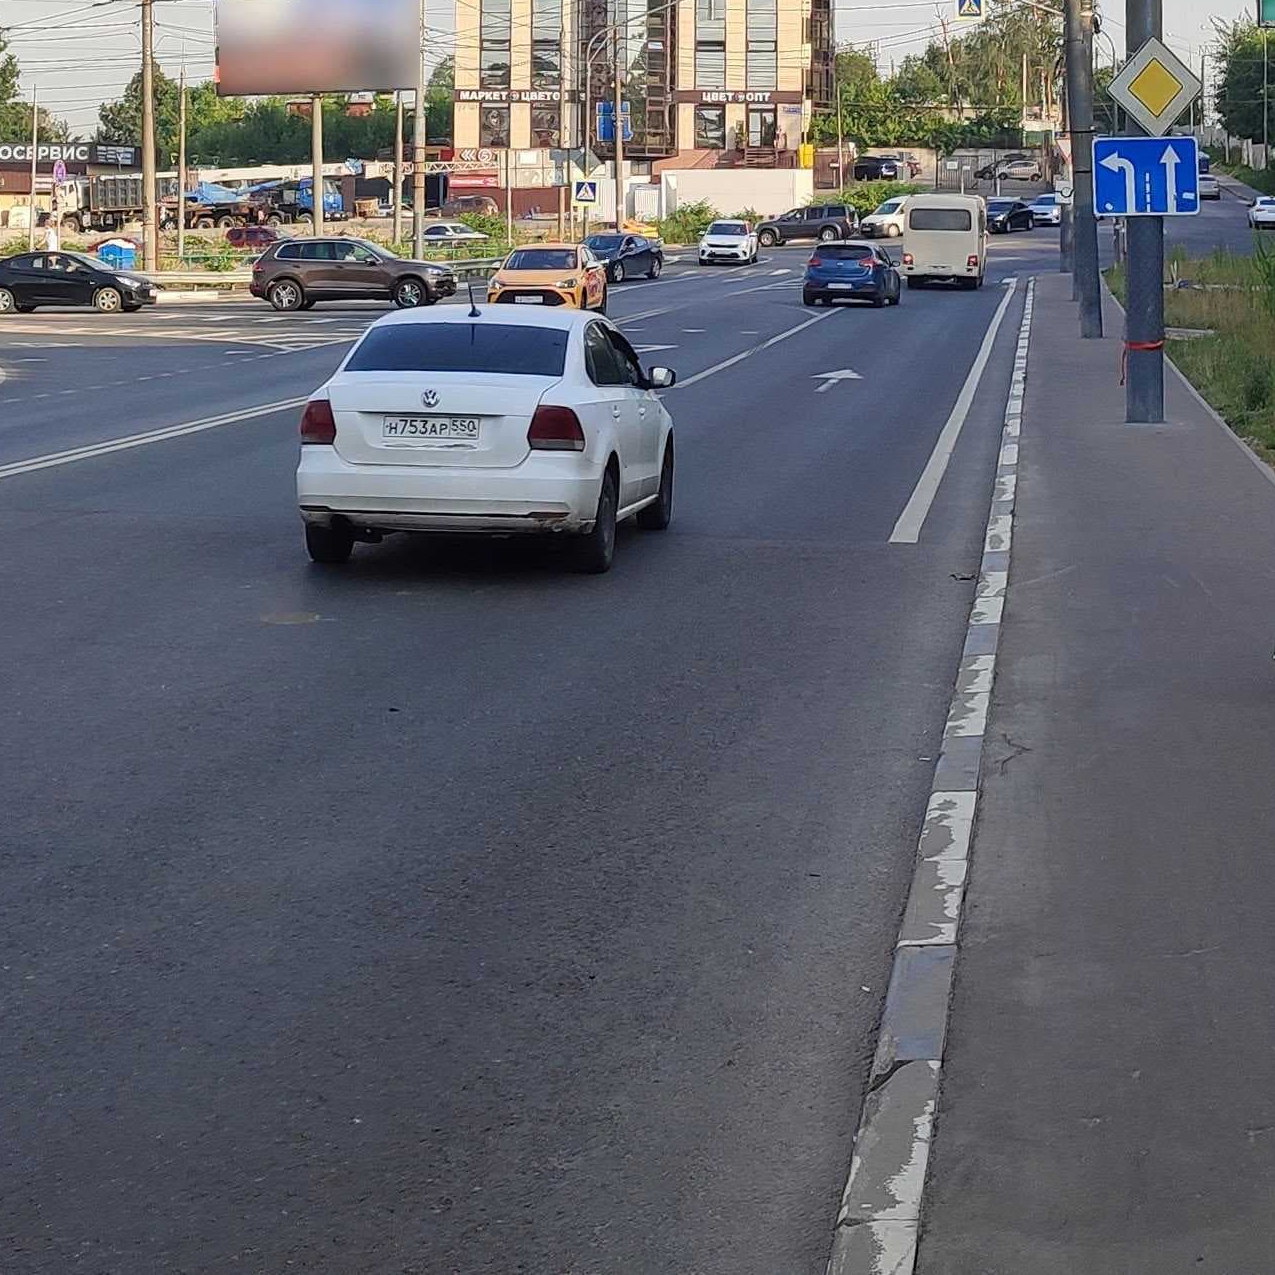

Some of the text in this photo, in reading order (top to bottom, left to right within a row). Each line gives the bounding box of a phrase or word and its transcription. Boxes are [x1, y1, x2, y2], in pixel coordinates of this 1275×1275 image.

[459, 91, 508, 101] МАРКЕТ
[702, 92, 771, 103] ЦВЕТ ОПТ
